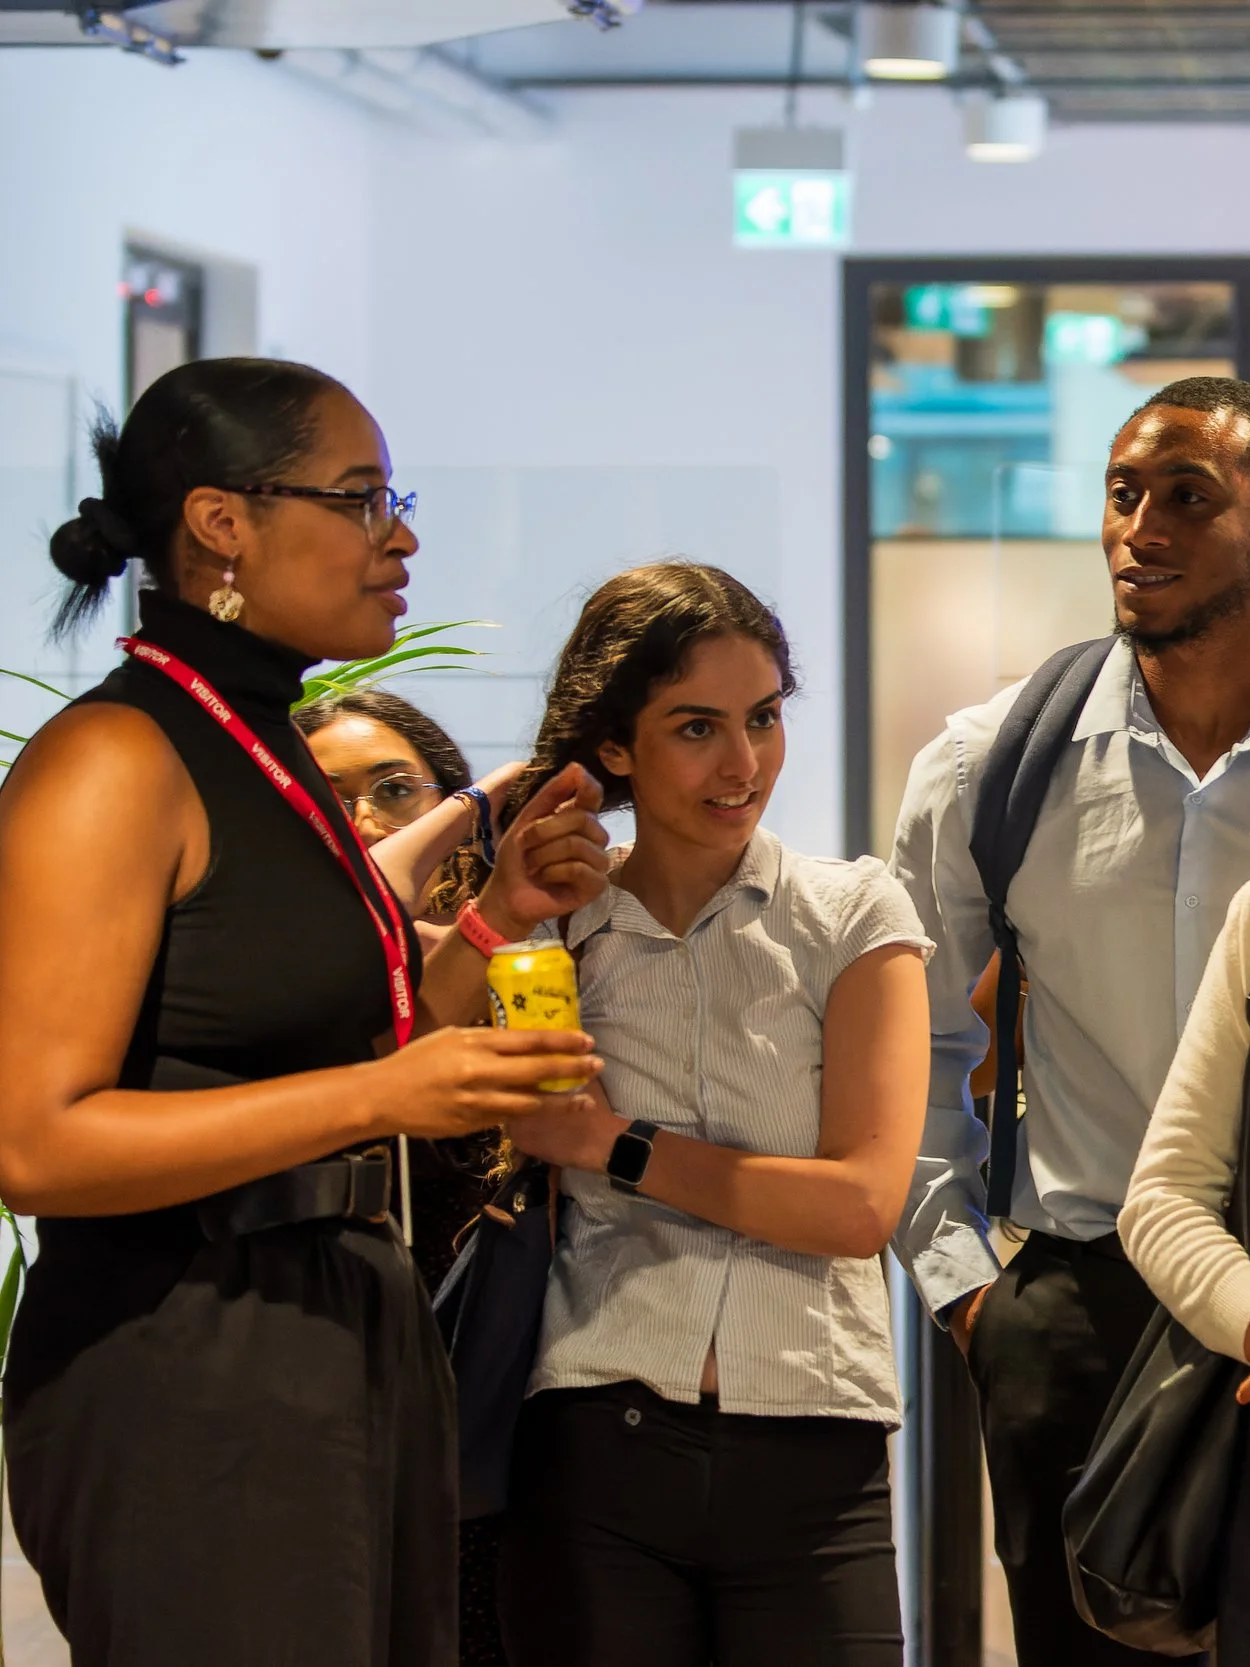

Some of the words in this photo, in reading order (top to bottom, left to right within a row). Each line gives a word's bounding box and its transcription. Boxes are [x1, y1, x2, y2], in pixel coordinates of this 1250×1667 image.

[190, 677, 232, 723] VISITOR
[252, 742, 292, 789] VISITOR
[392, 966, 410, 1019] VISITOR
